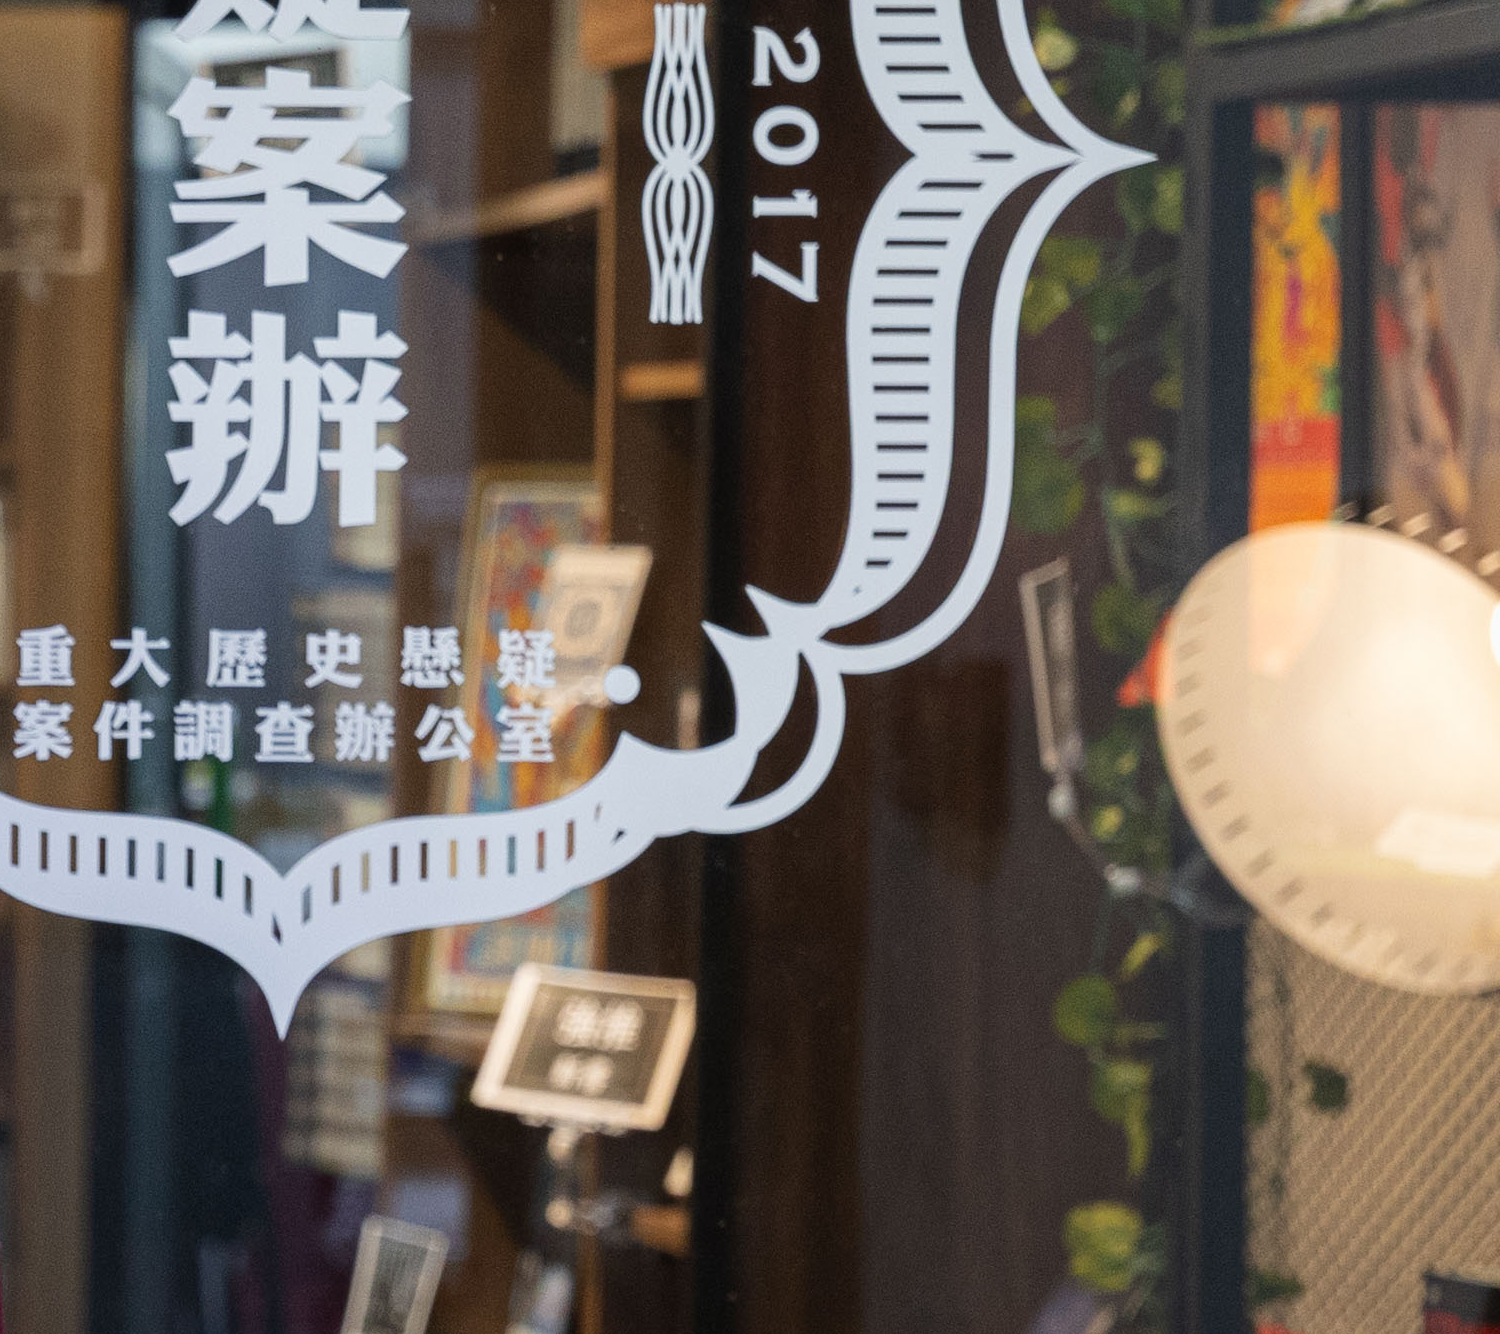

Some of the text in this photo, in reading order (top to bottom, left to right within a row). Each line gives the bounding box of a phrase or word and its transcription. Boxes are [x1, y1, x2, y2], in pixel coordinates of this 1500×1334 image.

[752, 27, 820, 303] 2017
[15, 624, 558, 690] 重大歷史懸疑
[13, 700, 558, 763] 案件調查辦公室
